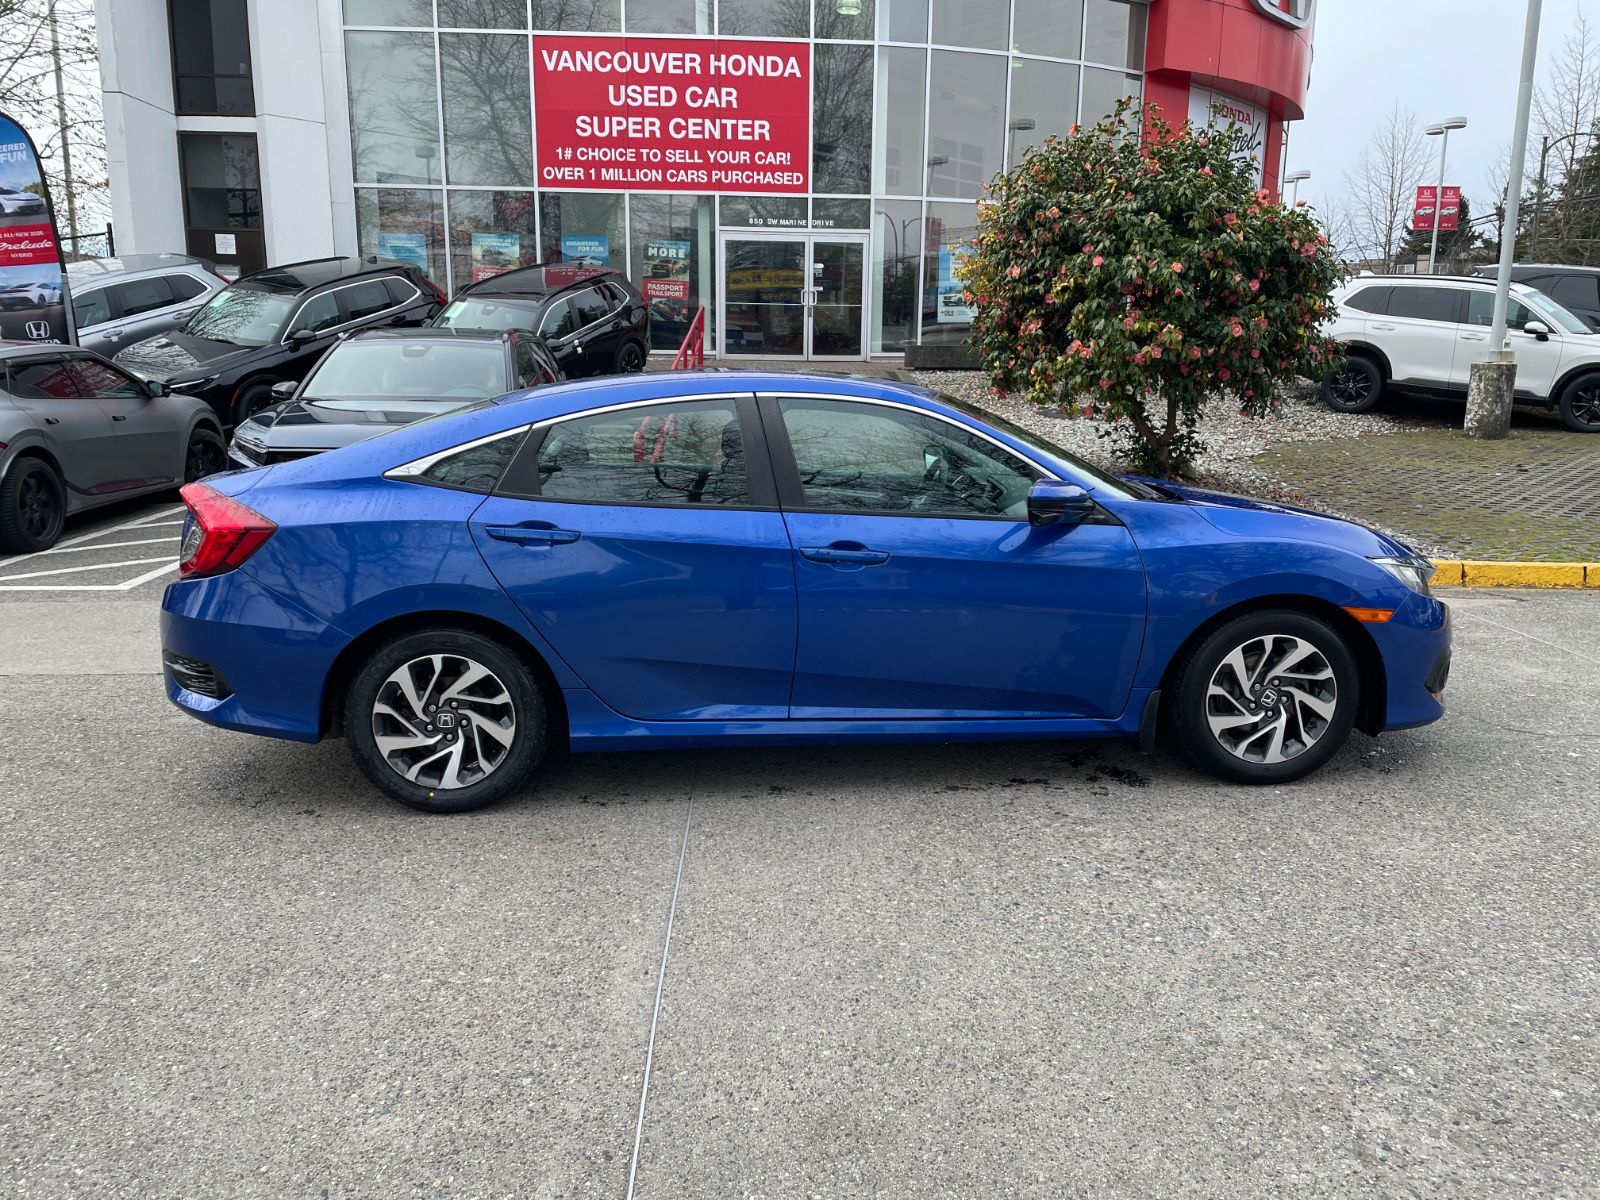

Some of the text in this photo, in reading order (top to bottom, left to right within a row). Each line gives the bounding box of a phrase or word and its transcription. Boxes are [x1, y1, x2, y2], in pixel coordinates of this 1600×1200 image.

[541, 50, 802, 78] VANCOUVER HONDA
[608, 84, 738, 109] USED CAR
[575, 115, 771, 141] SUPER CENTER
[555, 147, 792, 165] 1# CHOICE TO SELL YOUR CAR!
[543, 166, 804, 185] OVER 1 MILLION CARS PURCHASED
[748, 217, 764, 225] 850
[812, 219, 834, 227] DRIVE
[647, 247, 686, 259] MORE
[647, 283, 684, 292] PASSPORT
